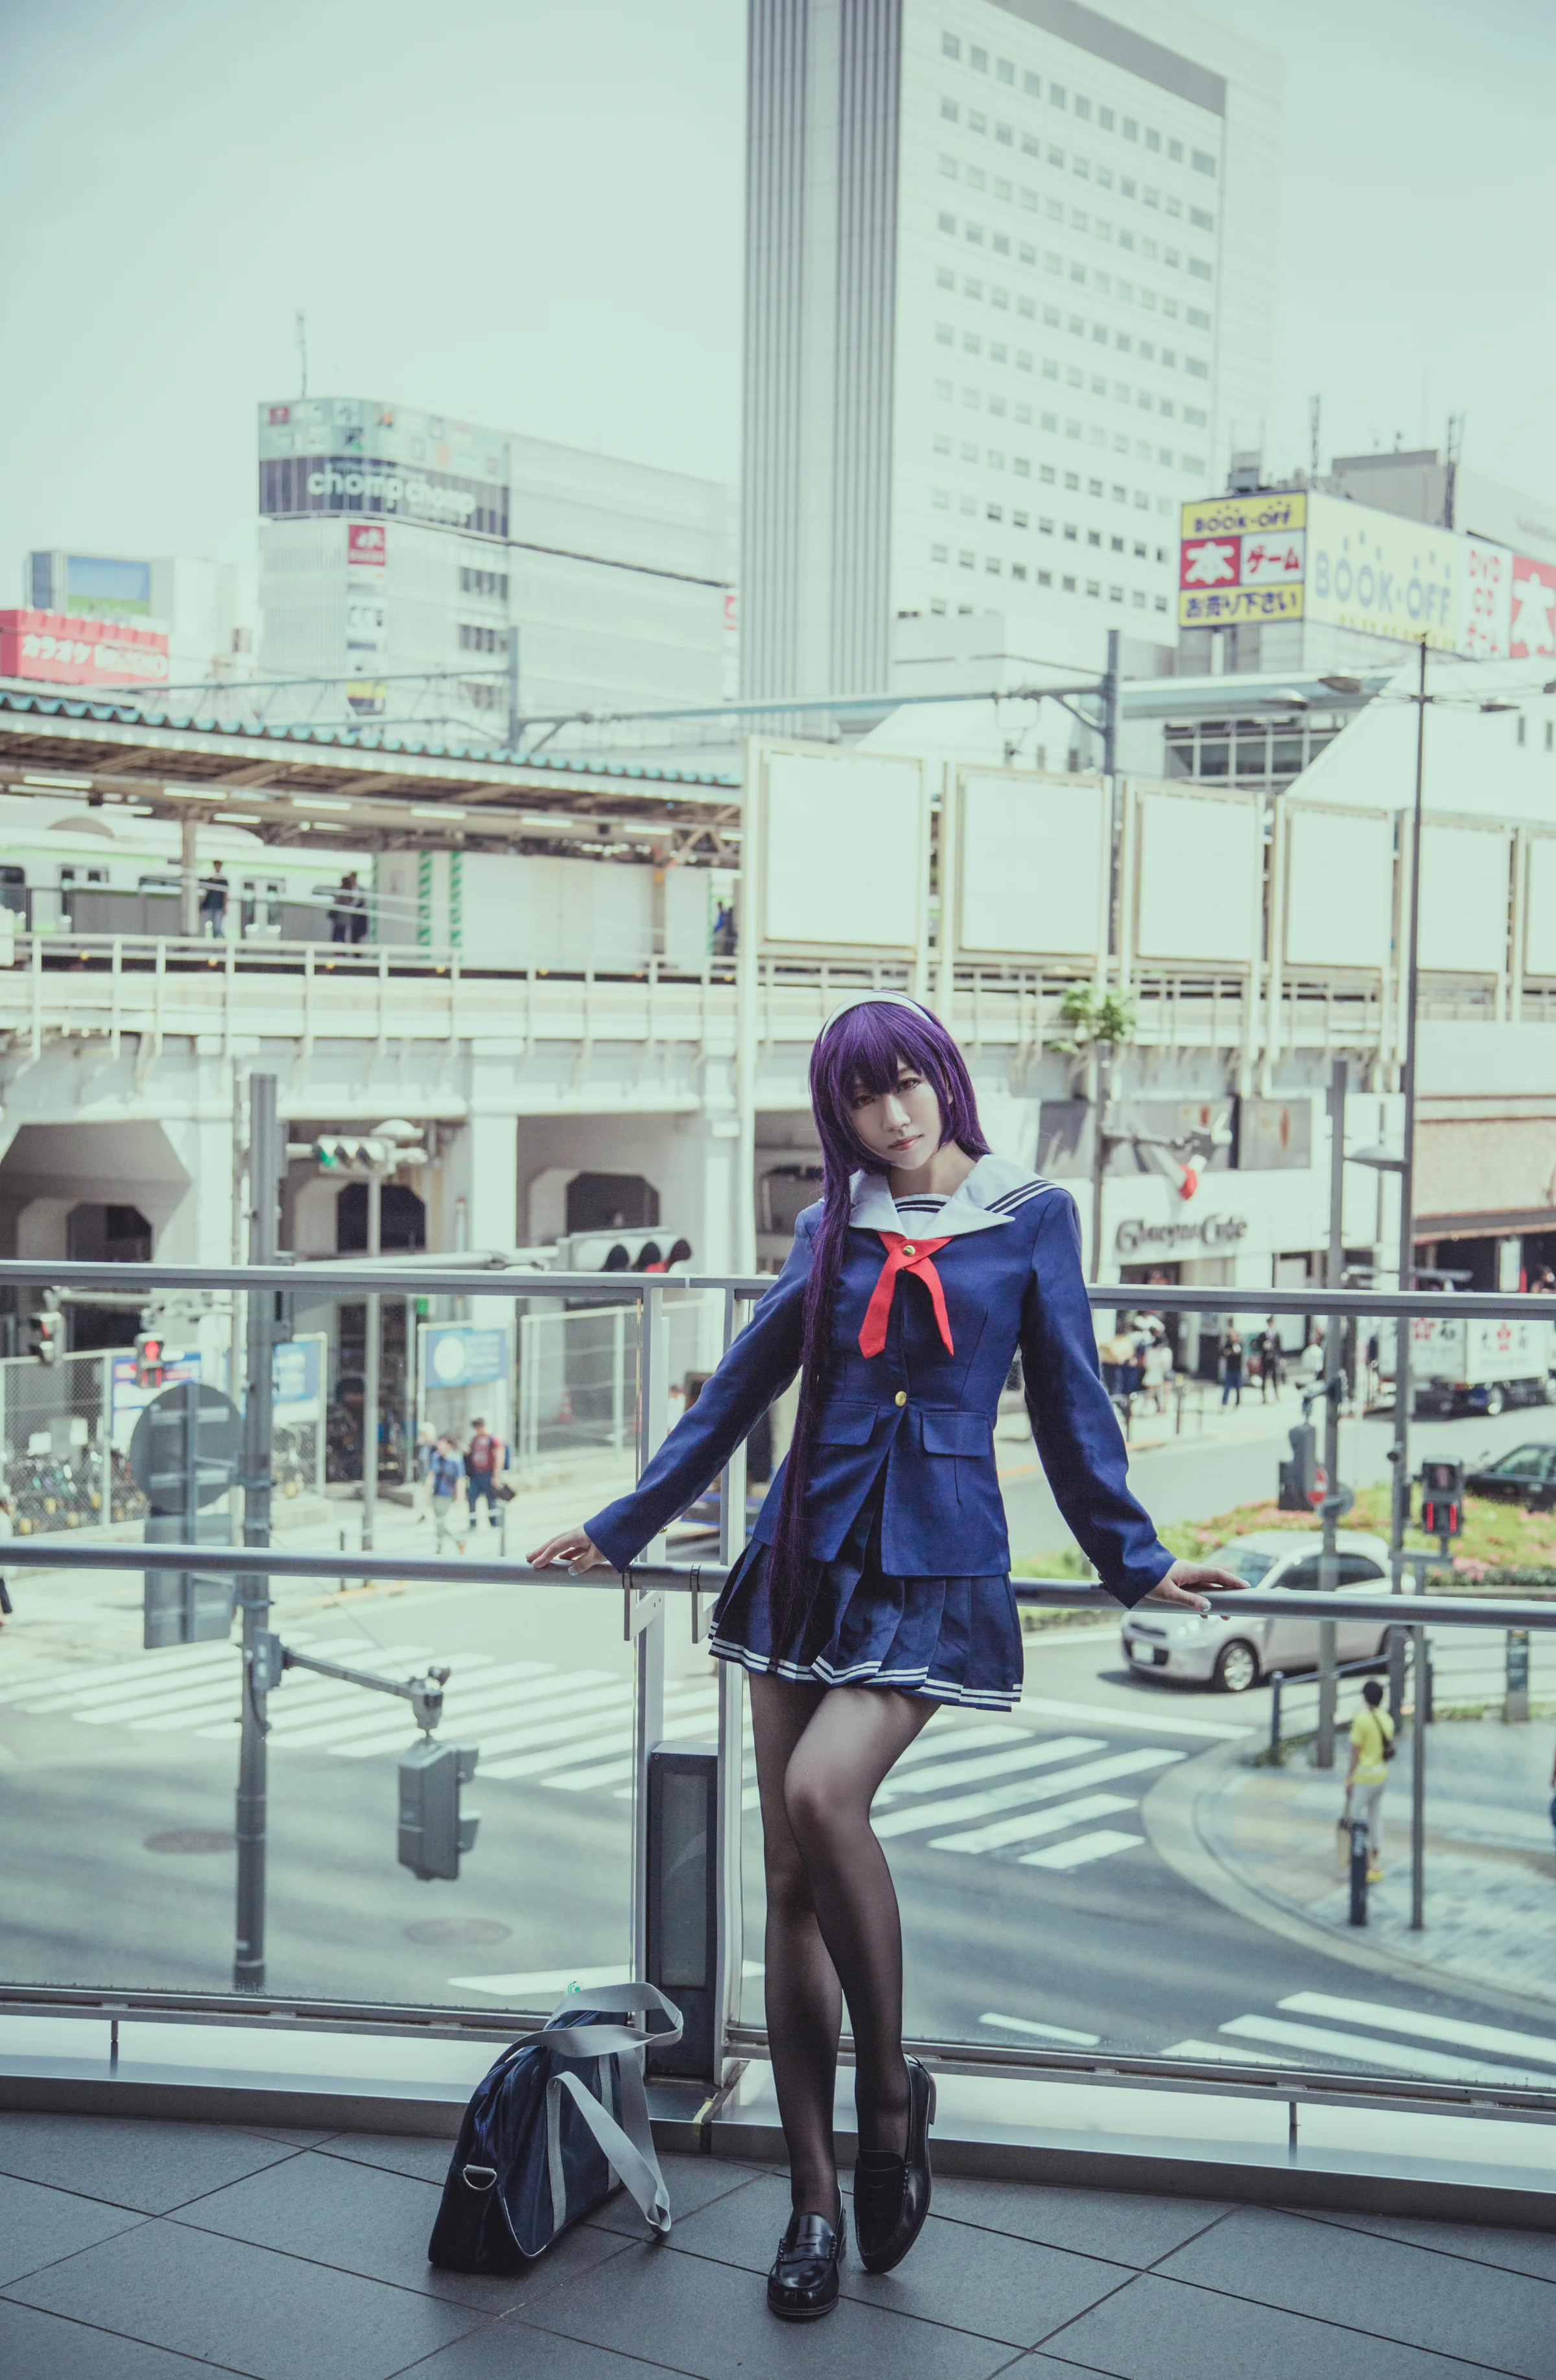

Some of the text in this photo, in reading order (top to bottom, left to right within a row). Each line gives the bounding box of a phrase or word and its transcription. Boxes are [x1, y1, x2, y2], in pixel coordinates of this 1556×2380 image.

[307, 462, 405, 509] chomp
[1185, 541, 1235, 584] 本
[1247, 545, 1299, 574] ゲーム
[1186, 592, 1296, 618] お売り下さい
